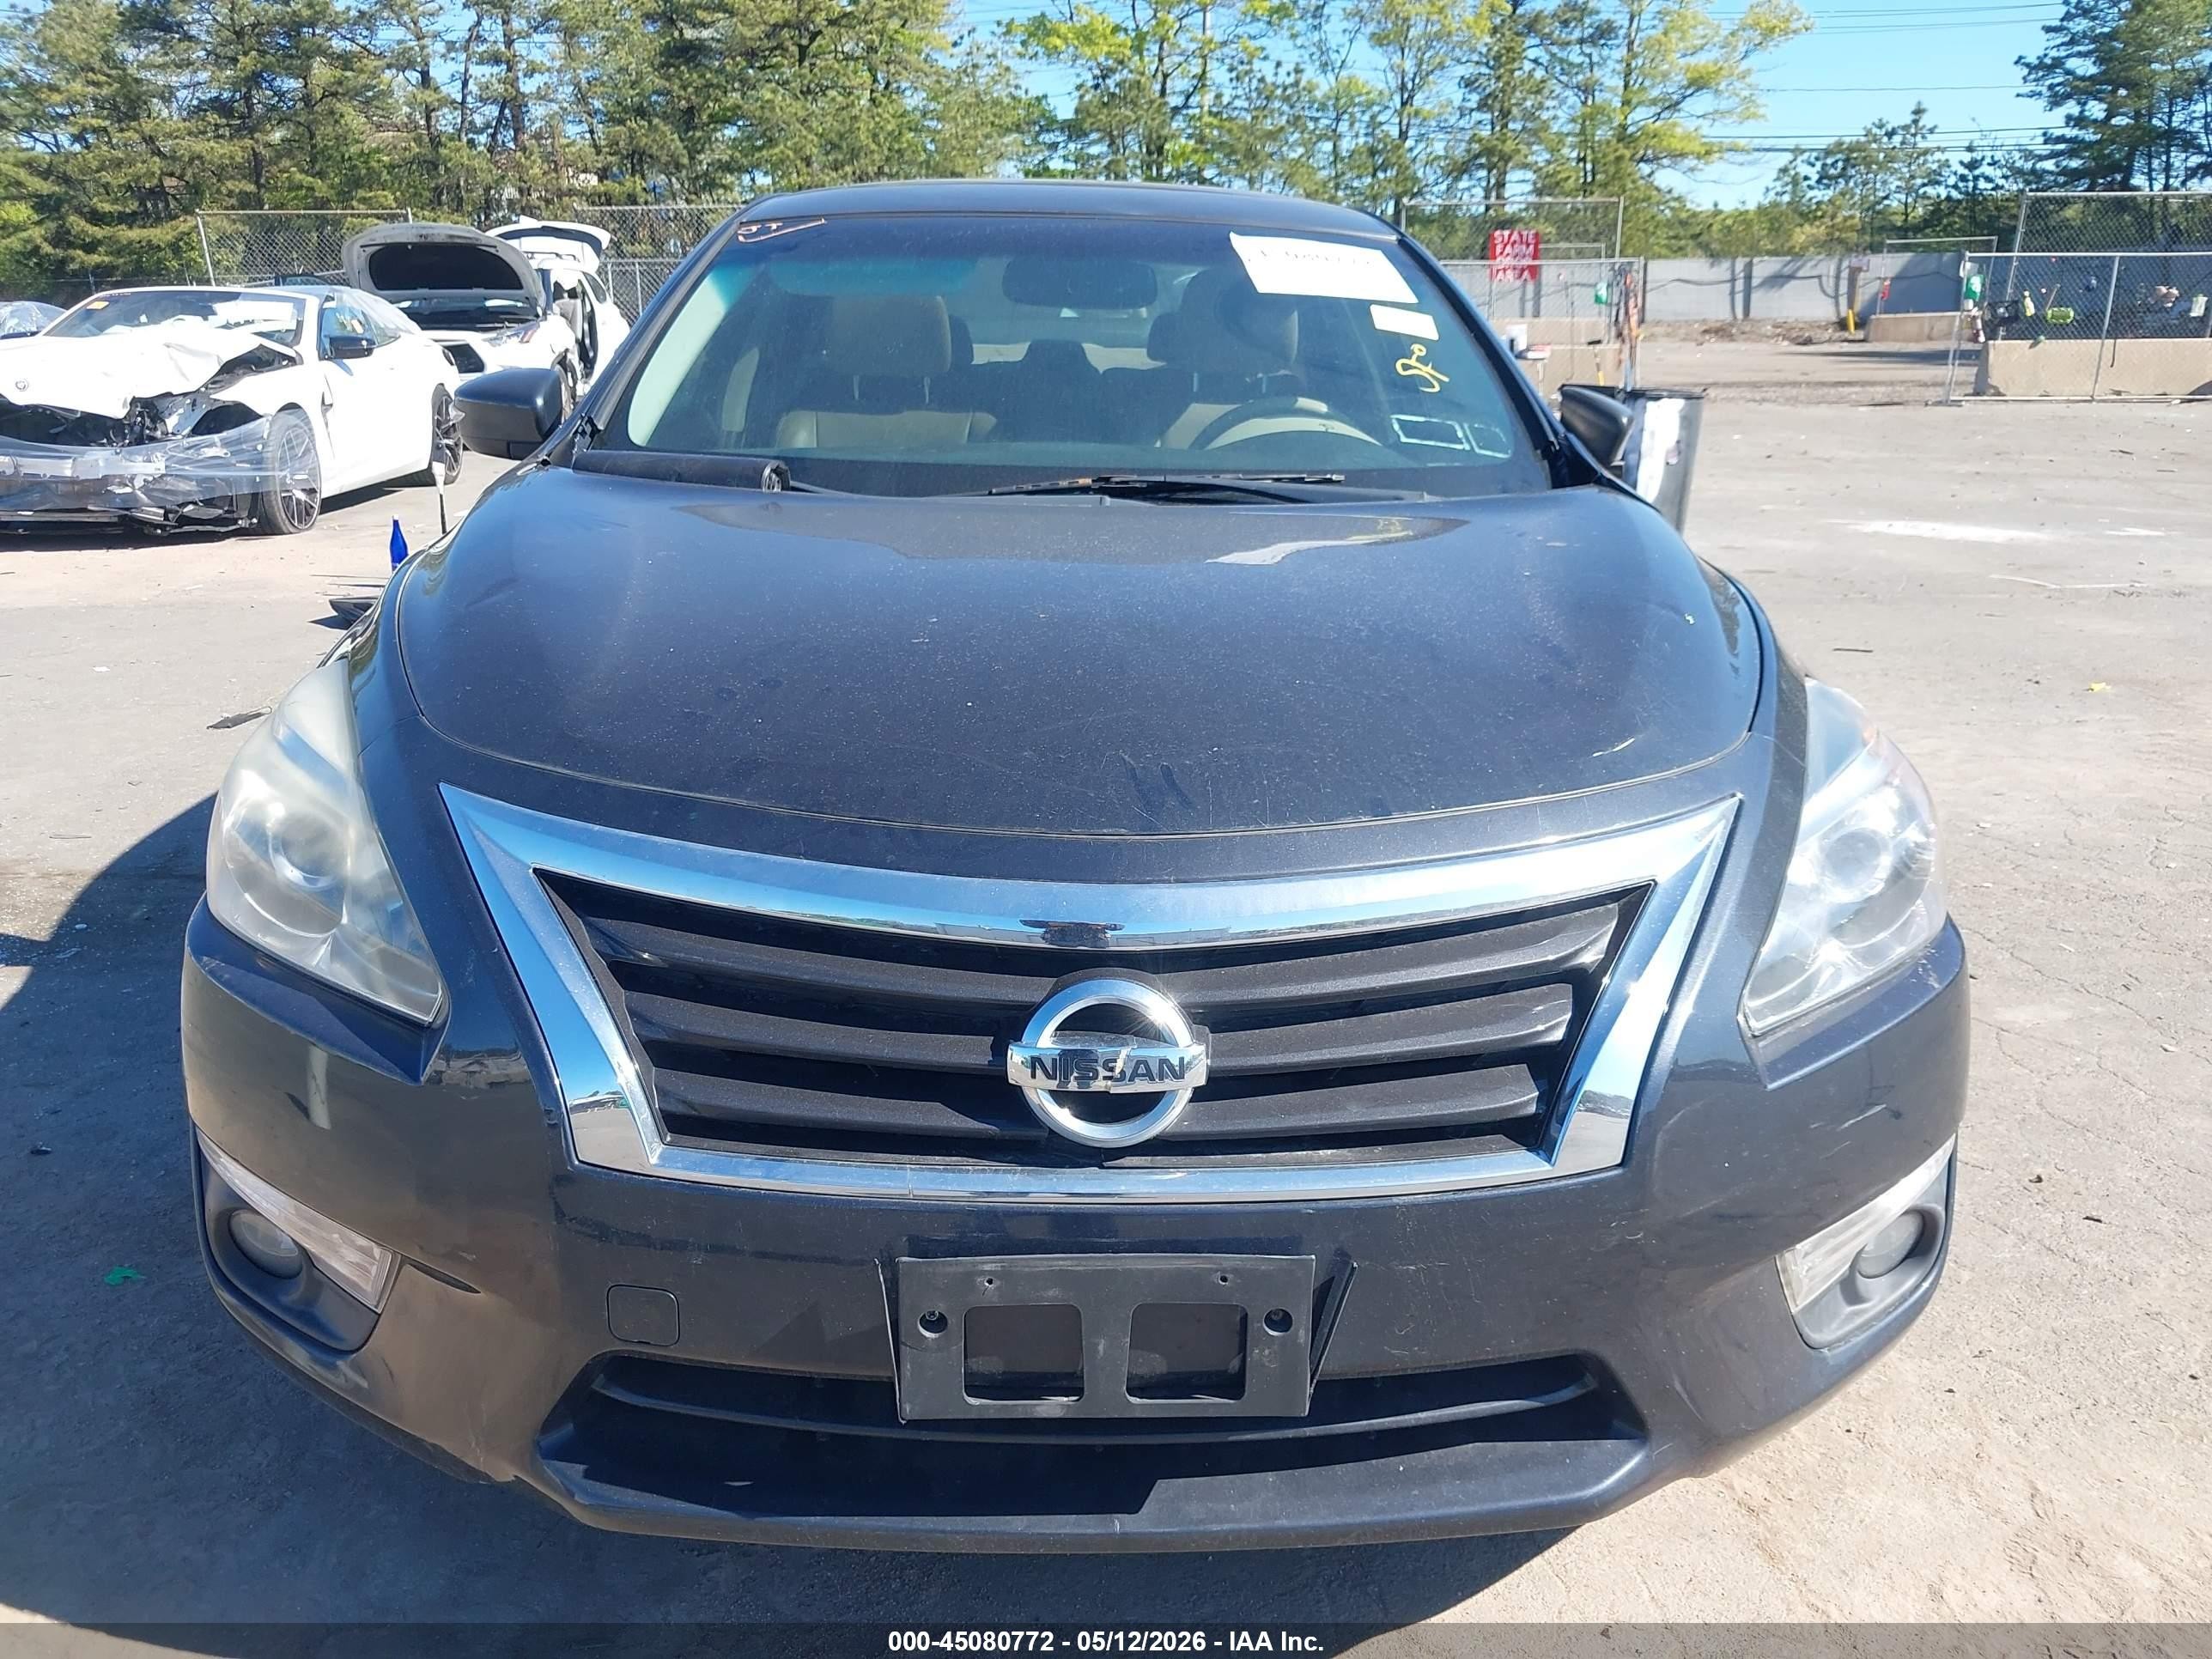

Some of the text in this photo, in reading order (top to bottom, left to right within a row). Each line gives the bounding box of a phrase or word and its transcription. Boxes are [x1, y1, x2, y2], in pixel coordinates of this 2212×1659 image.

[1494, 229, 1536, 244] STATE
[1496, 244, 1534, 258] FARM
[1030, 1056, 1185, 1083] NISSAN
